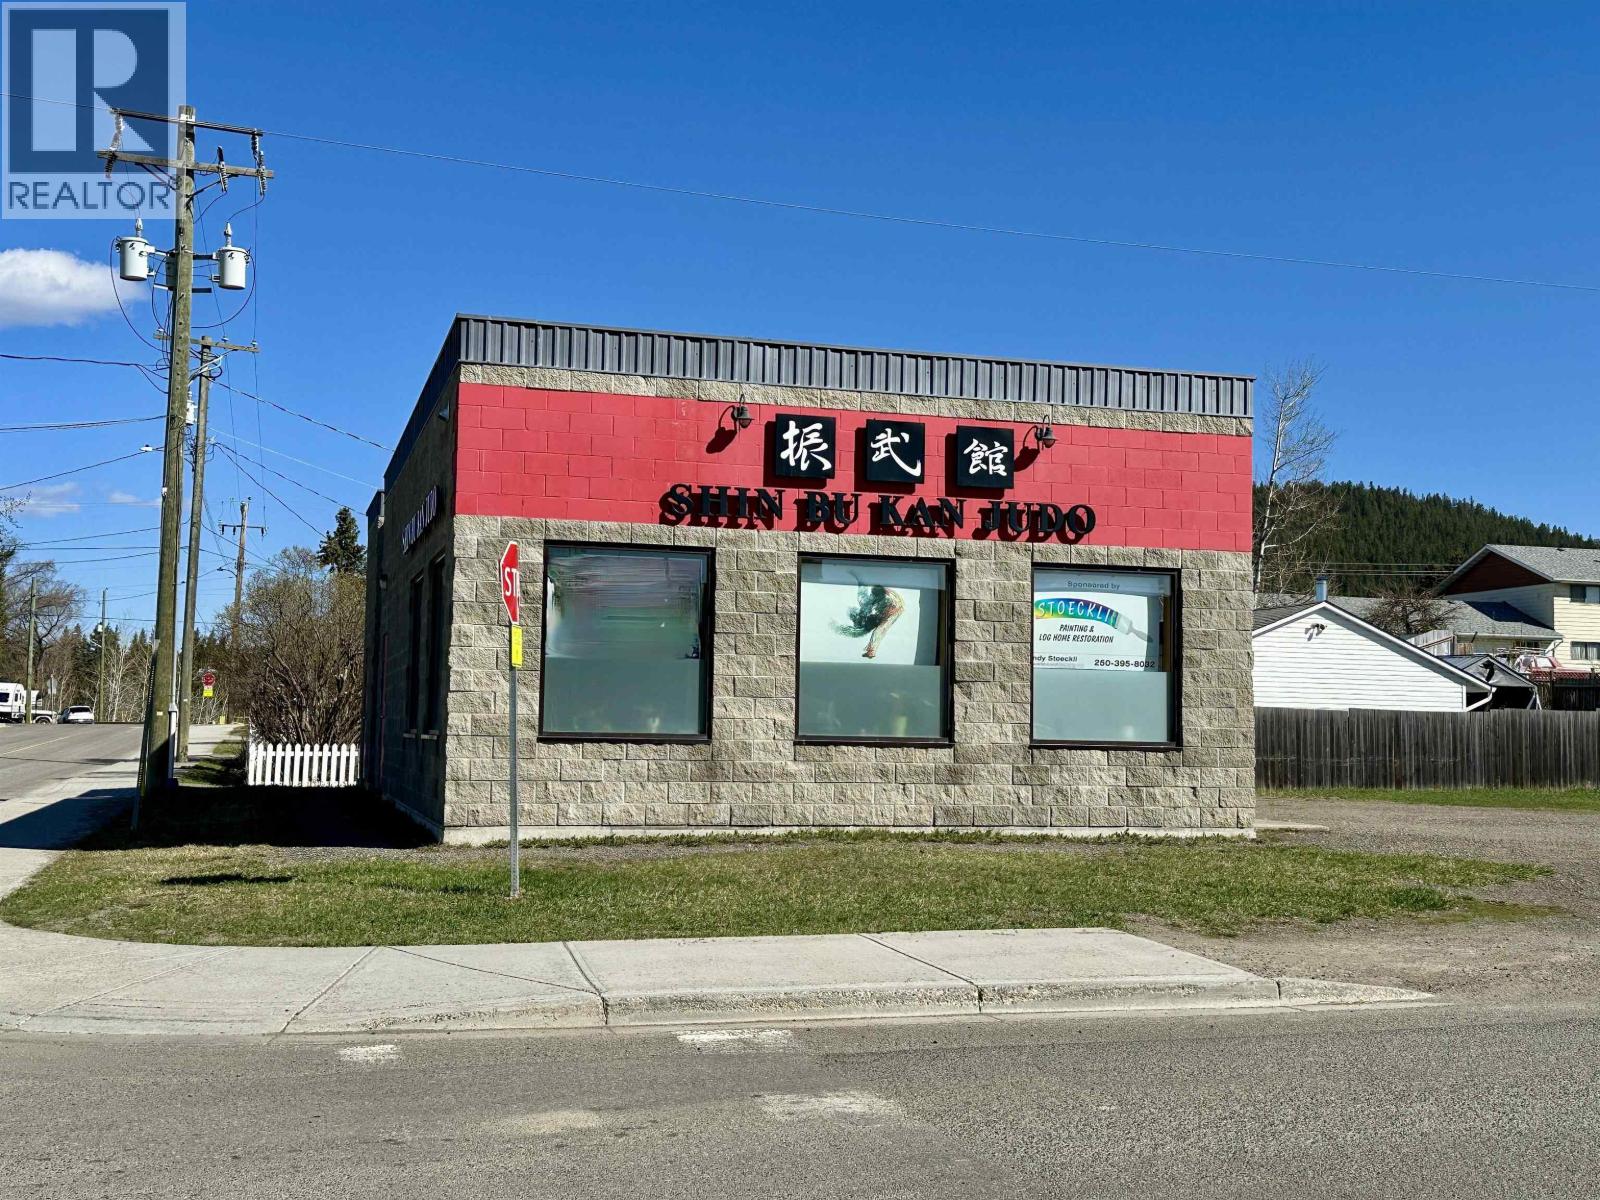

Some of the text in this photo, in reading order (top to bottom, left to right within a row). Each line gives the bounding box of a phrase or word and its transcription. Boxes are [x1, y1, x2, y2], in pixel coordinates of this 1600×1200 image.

[780, 420, 1009, 477] 振 武 館
[669, 483, 1096, 536] SHIN BU KAN JUDO
[1067, 580, 1109, 589] Sponsored
[1038, 600, 1111, 623] STOECKLI
[1059, 624, 1095, 633] PAINTING &
[1039, 633, 1114, 643] LOG HOME RESTORATION
